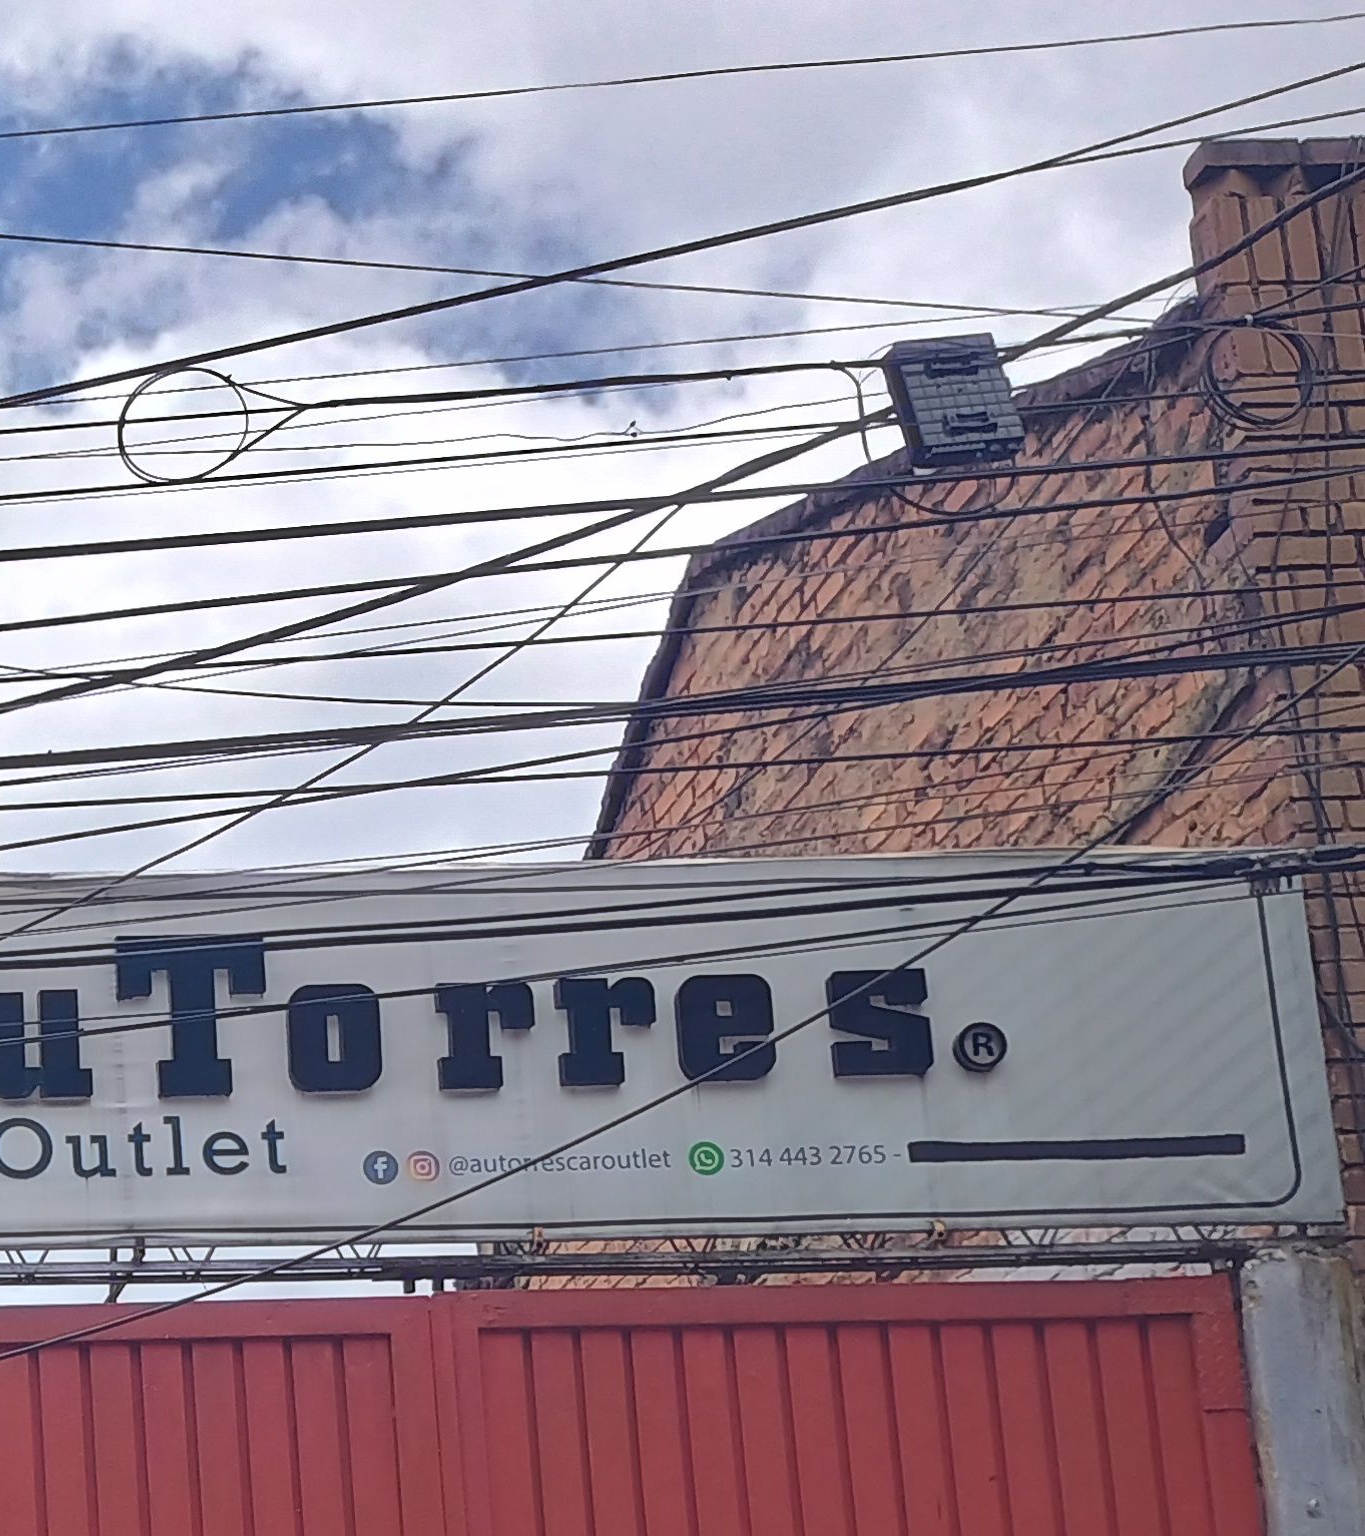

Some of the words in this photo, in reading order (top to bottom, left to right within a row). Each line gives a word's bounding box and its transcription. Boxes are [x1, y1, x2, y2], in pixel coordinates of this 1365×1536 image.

[729, 1146, 773, 1170] 314
[779, 1146, 822, 1168] 443
[827, 1144, 887, 1168] 2765
